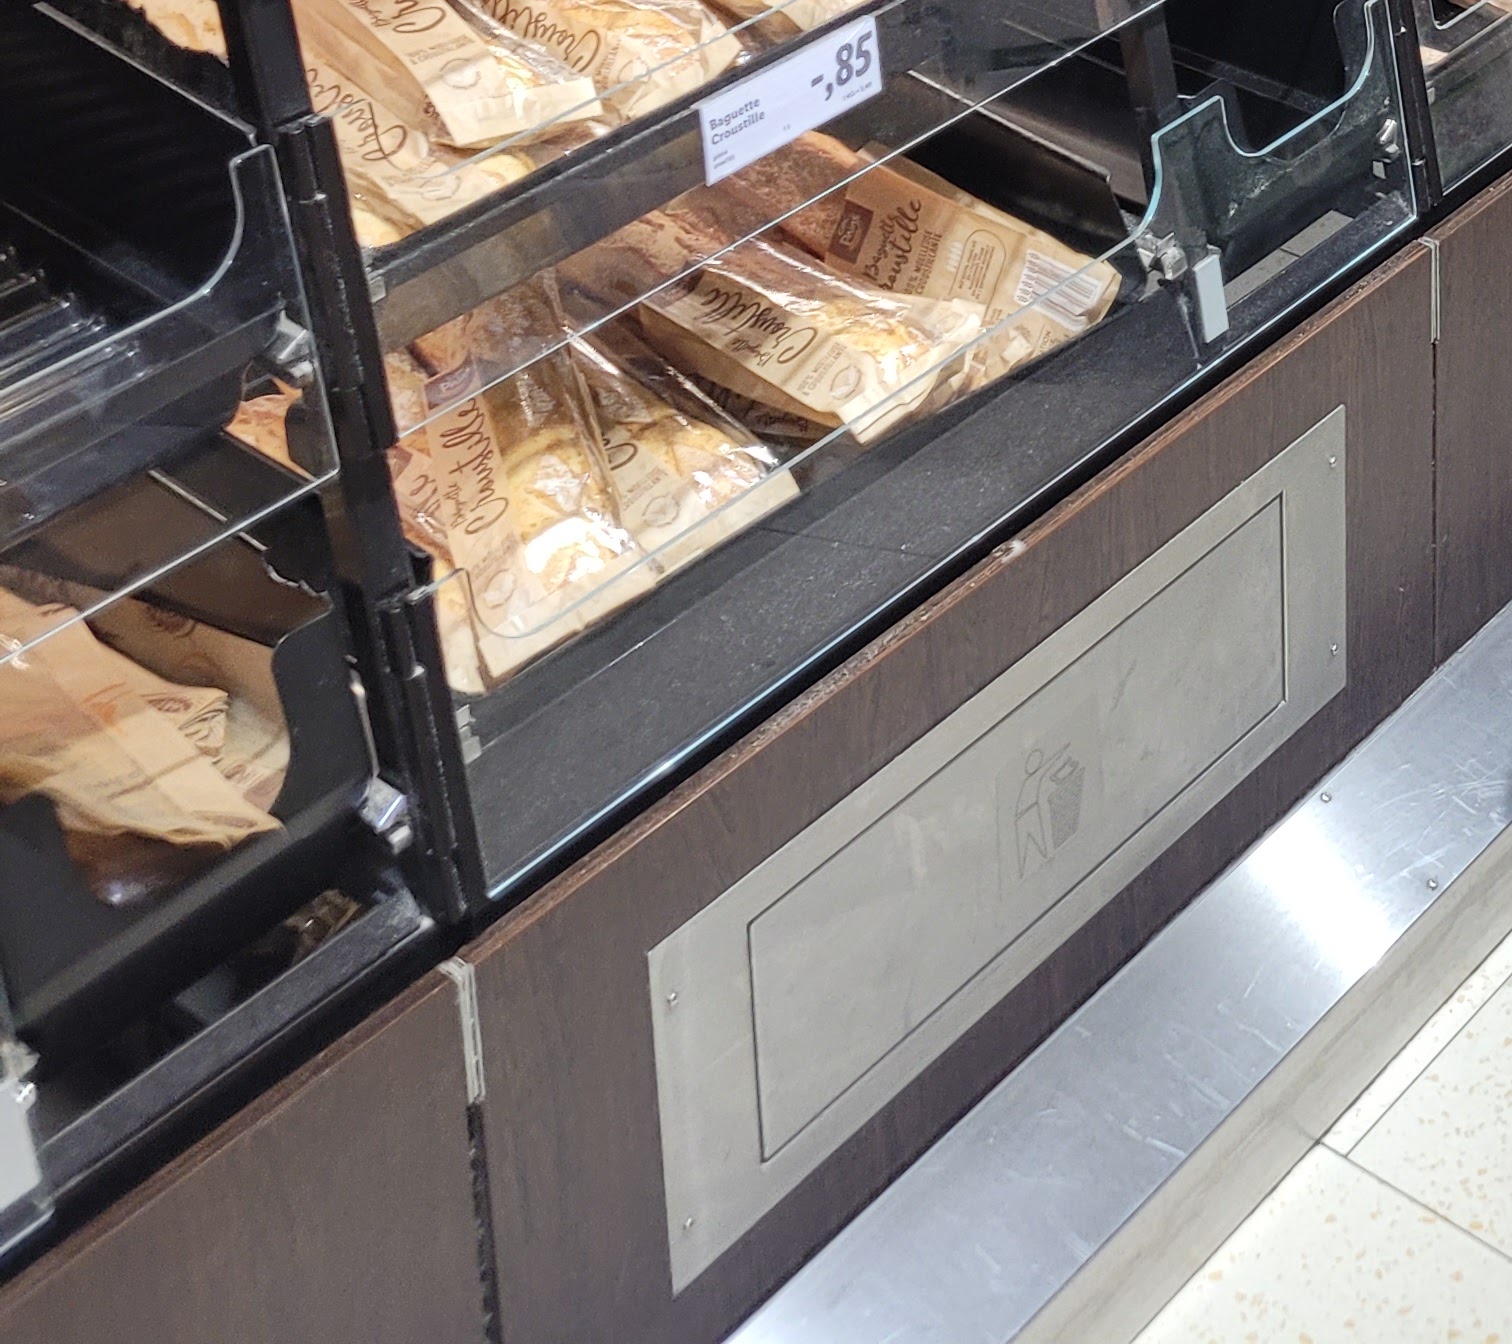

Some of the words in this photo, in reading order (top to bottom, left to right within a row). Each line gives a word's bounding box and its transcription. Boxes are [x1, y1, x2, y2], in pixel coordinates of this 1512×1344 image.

[811, 30, 873, 101] -,85
[709, 97, 760, 131] Baguette
[711, 111, 766, 145] Croustille
[878, 199, 922, 291] roustille
